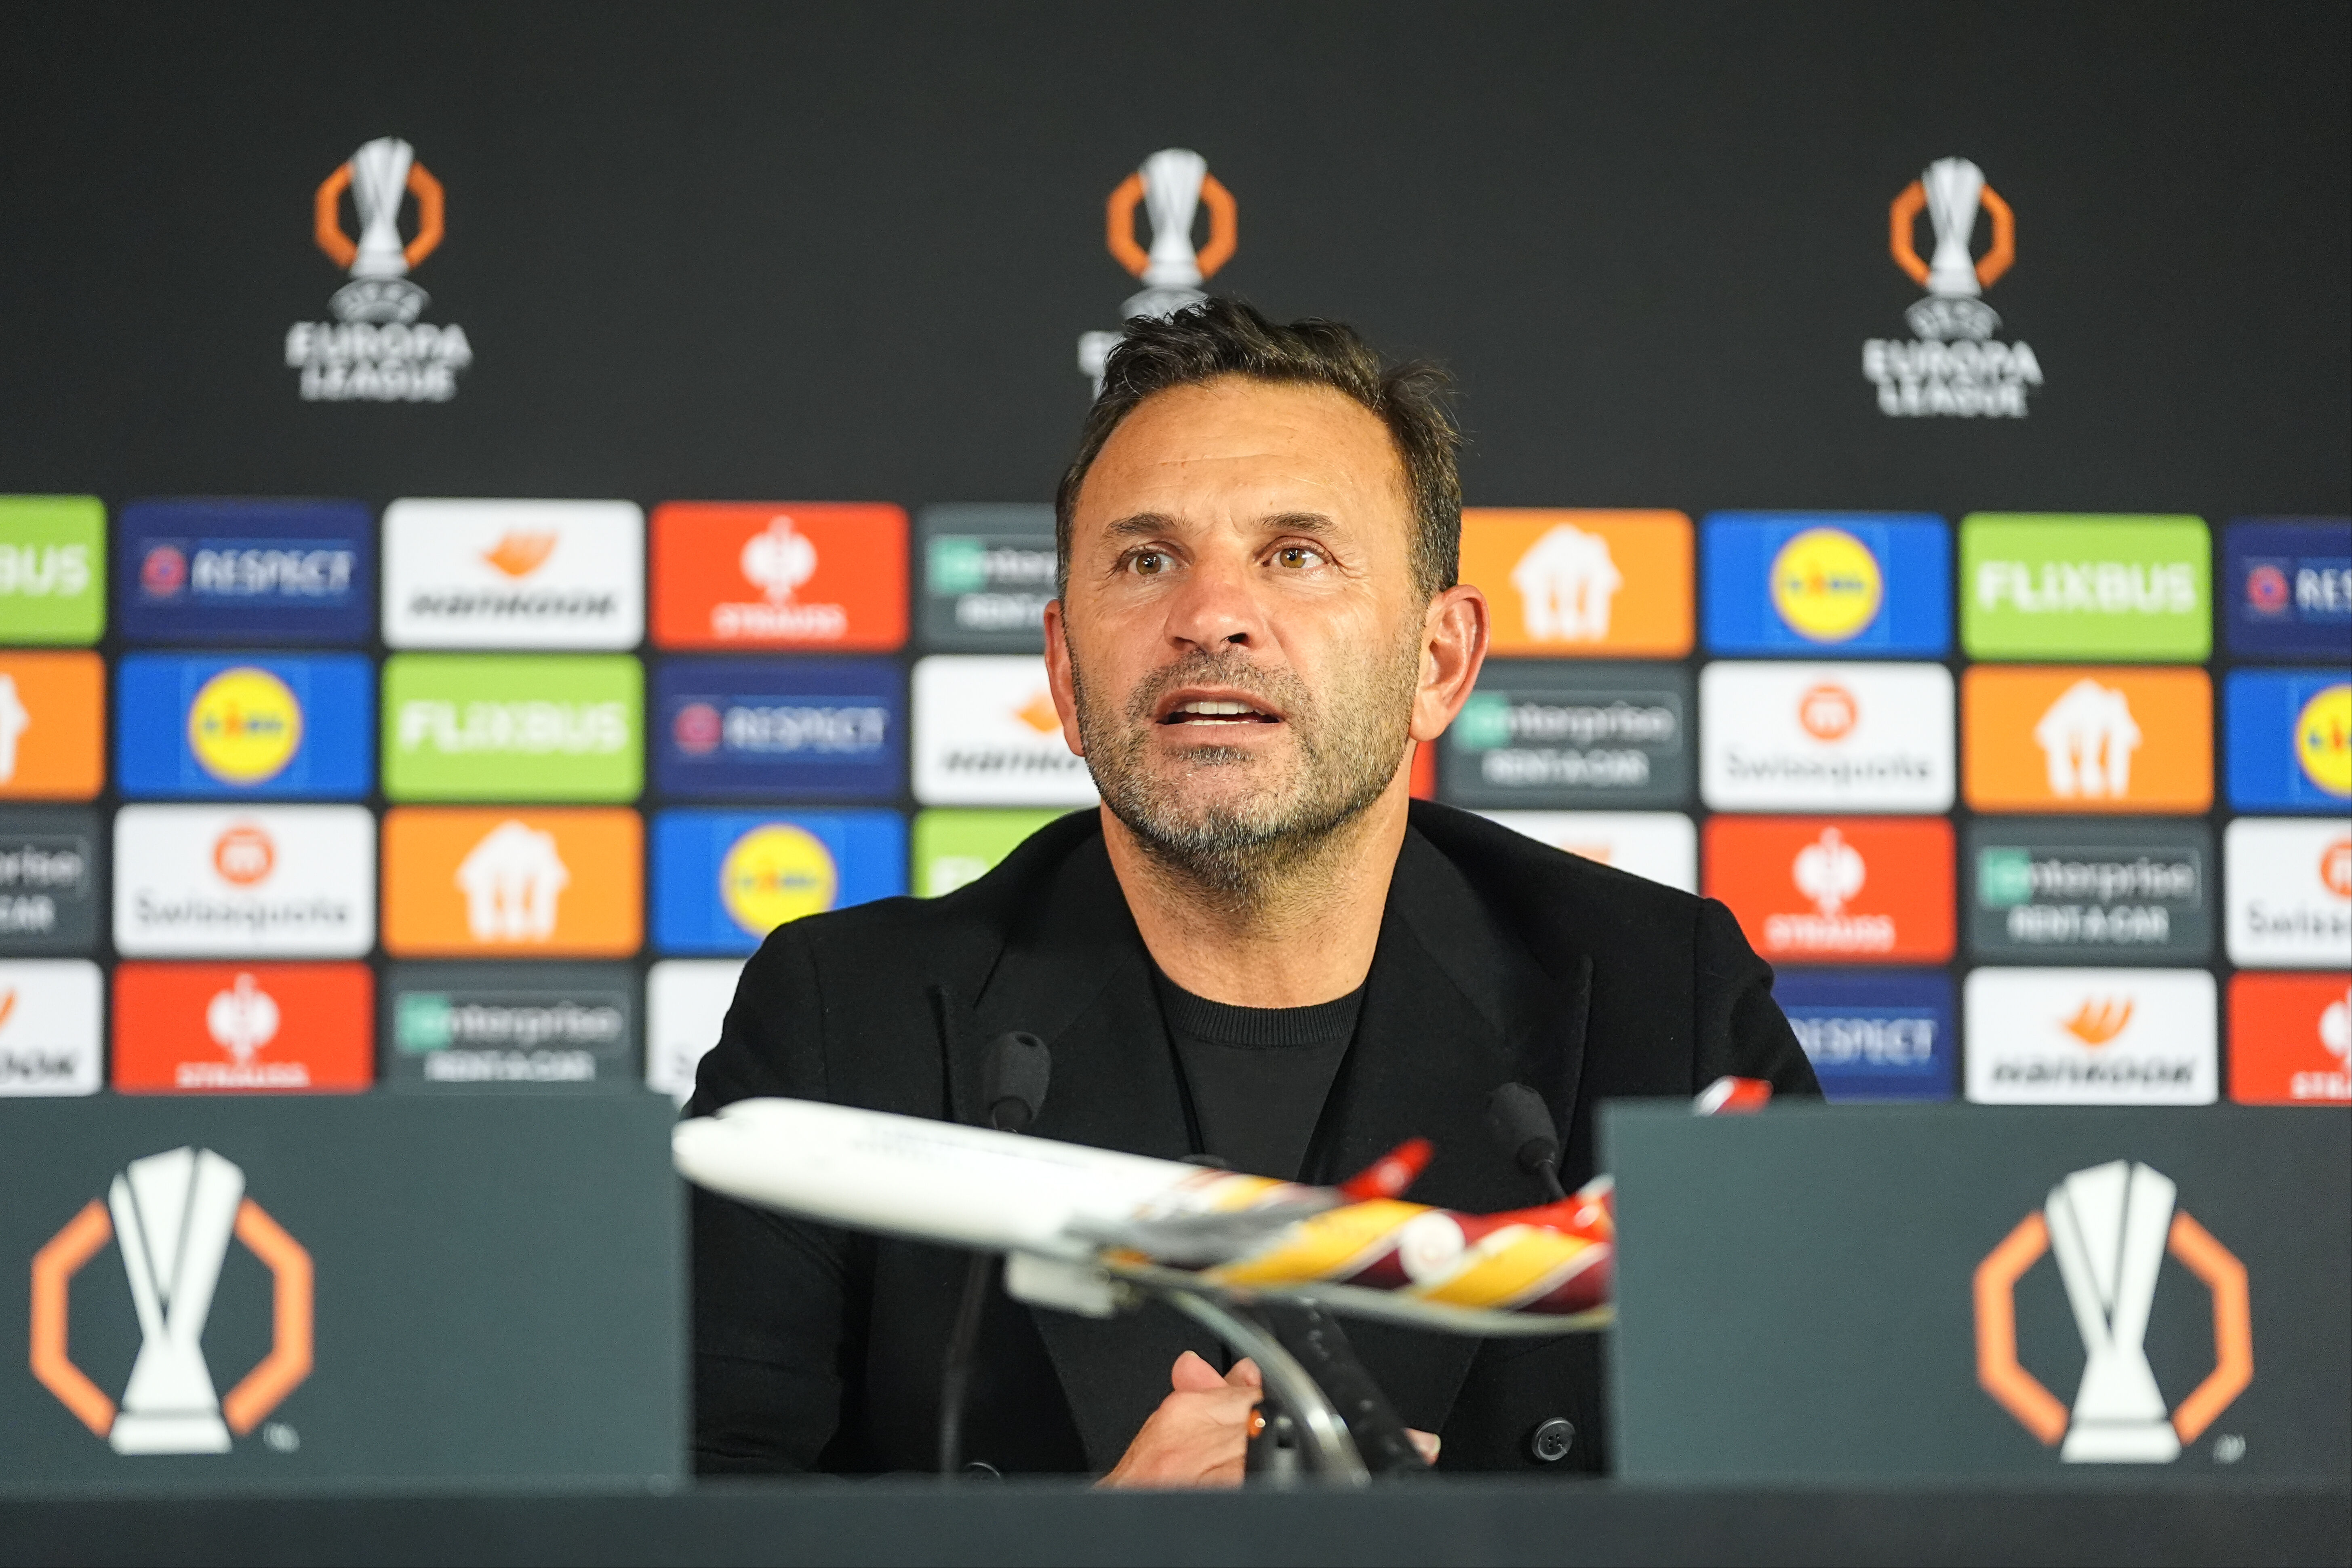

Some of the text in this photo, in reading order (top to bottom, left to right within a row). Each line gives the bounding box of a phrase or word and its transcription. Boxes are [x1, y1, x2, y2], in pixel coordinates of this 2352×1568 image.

[286, 322, 472, 366] EUROPA
[1863, 338, 2044, 385] EUROPA
[300, 364, 457, 401] LEAGUE
[192, 549, 355, 596] RESPECT
